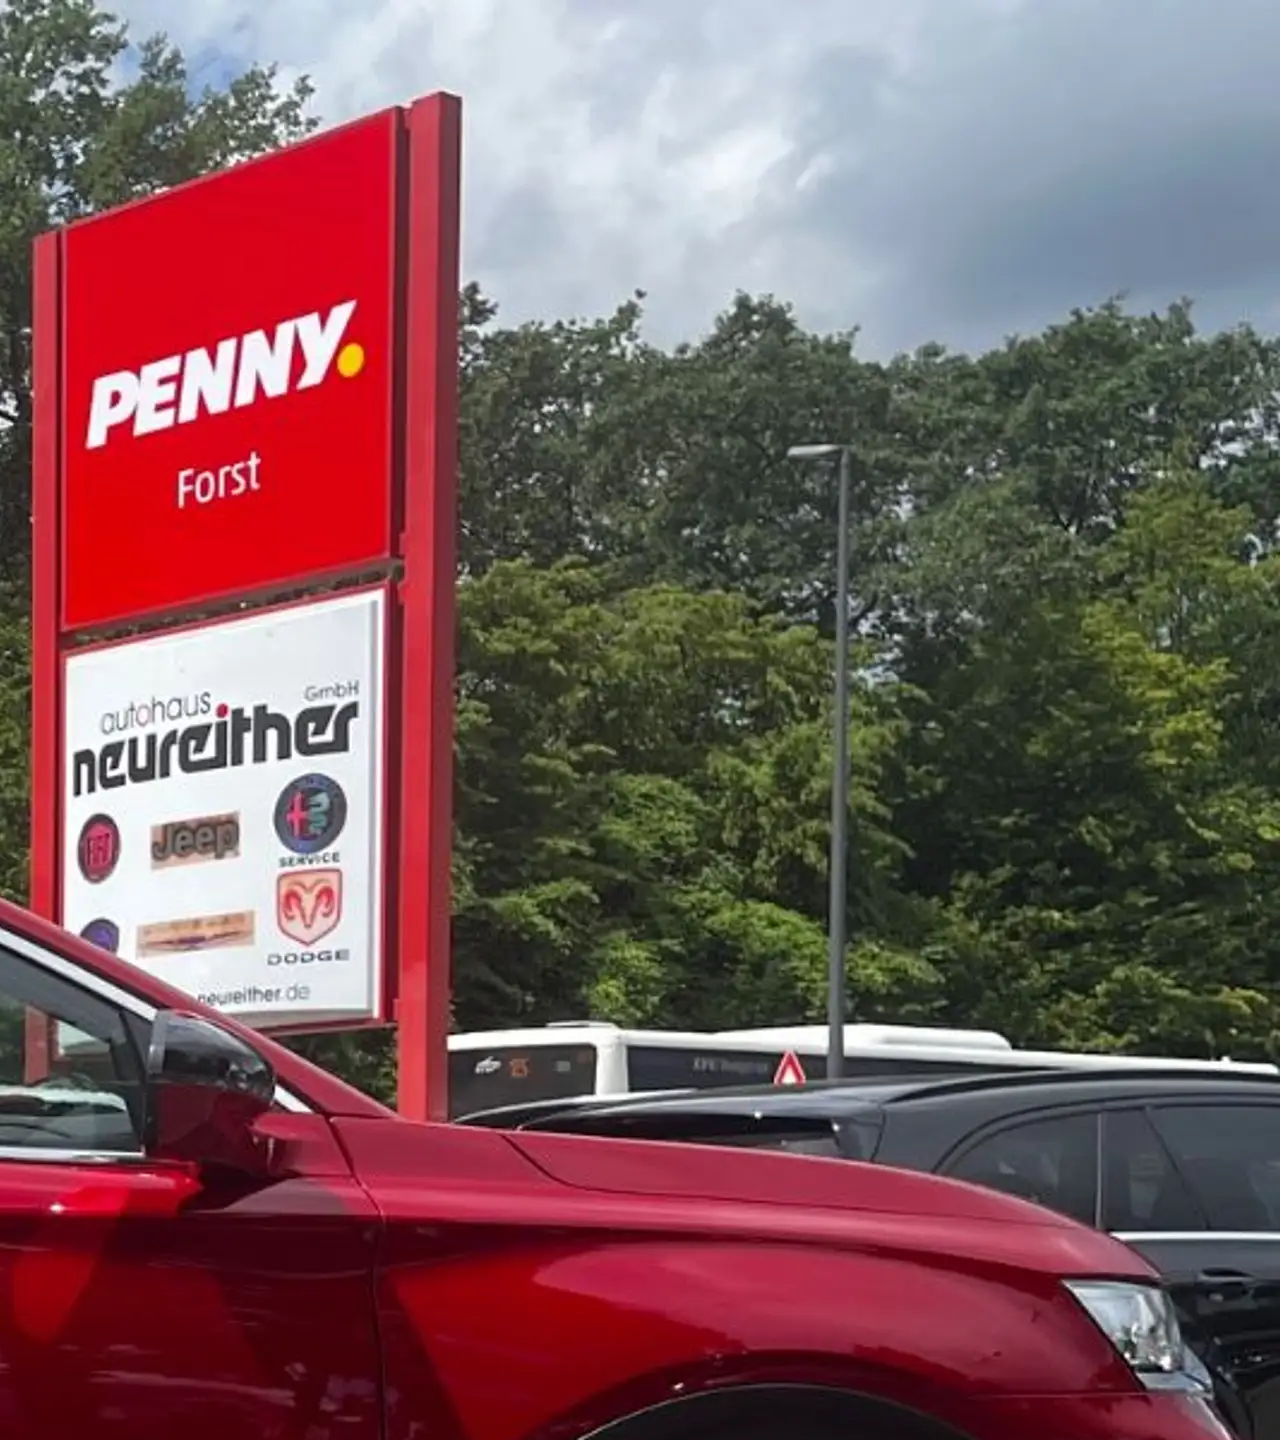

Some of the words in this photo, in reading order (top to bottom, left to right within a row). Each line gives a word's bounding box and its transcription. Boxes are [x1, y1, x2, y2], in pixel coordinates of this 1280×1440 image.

[177, 451, 261, 509] Forst
[304, 680, 360, 701] GmbH
[100, 691, 211, 735] autohaus
[72, 700, 359, 797] neureither
[150, 820, 240, 861] Jeep
[278, 851, 341, 868] SERVICE
[266, 948, 350, 966] DODGE
